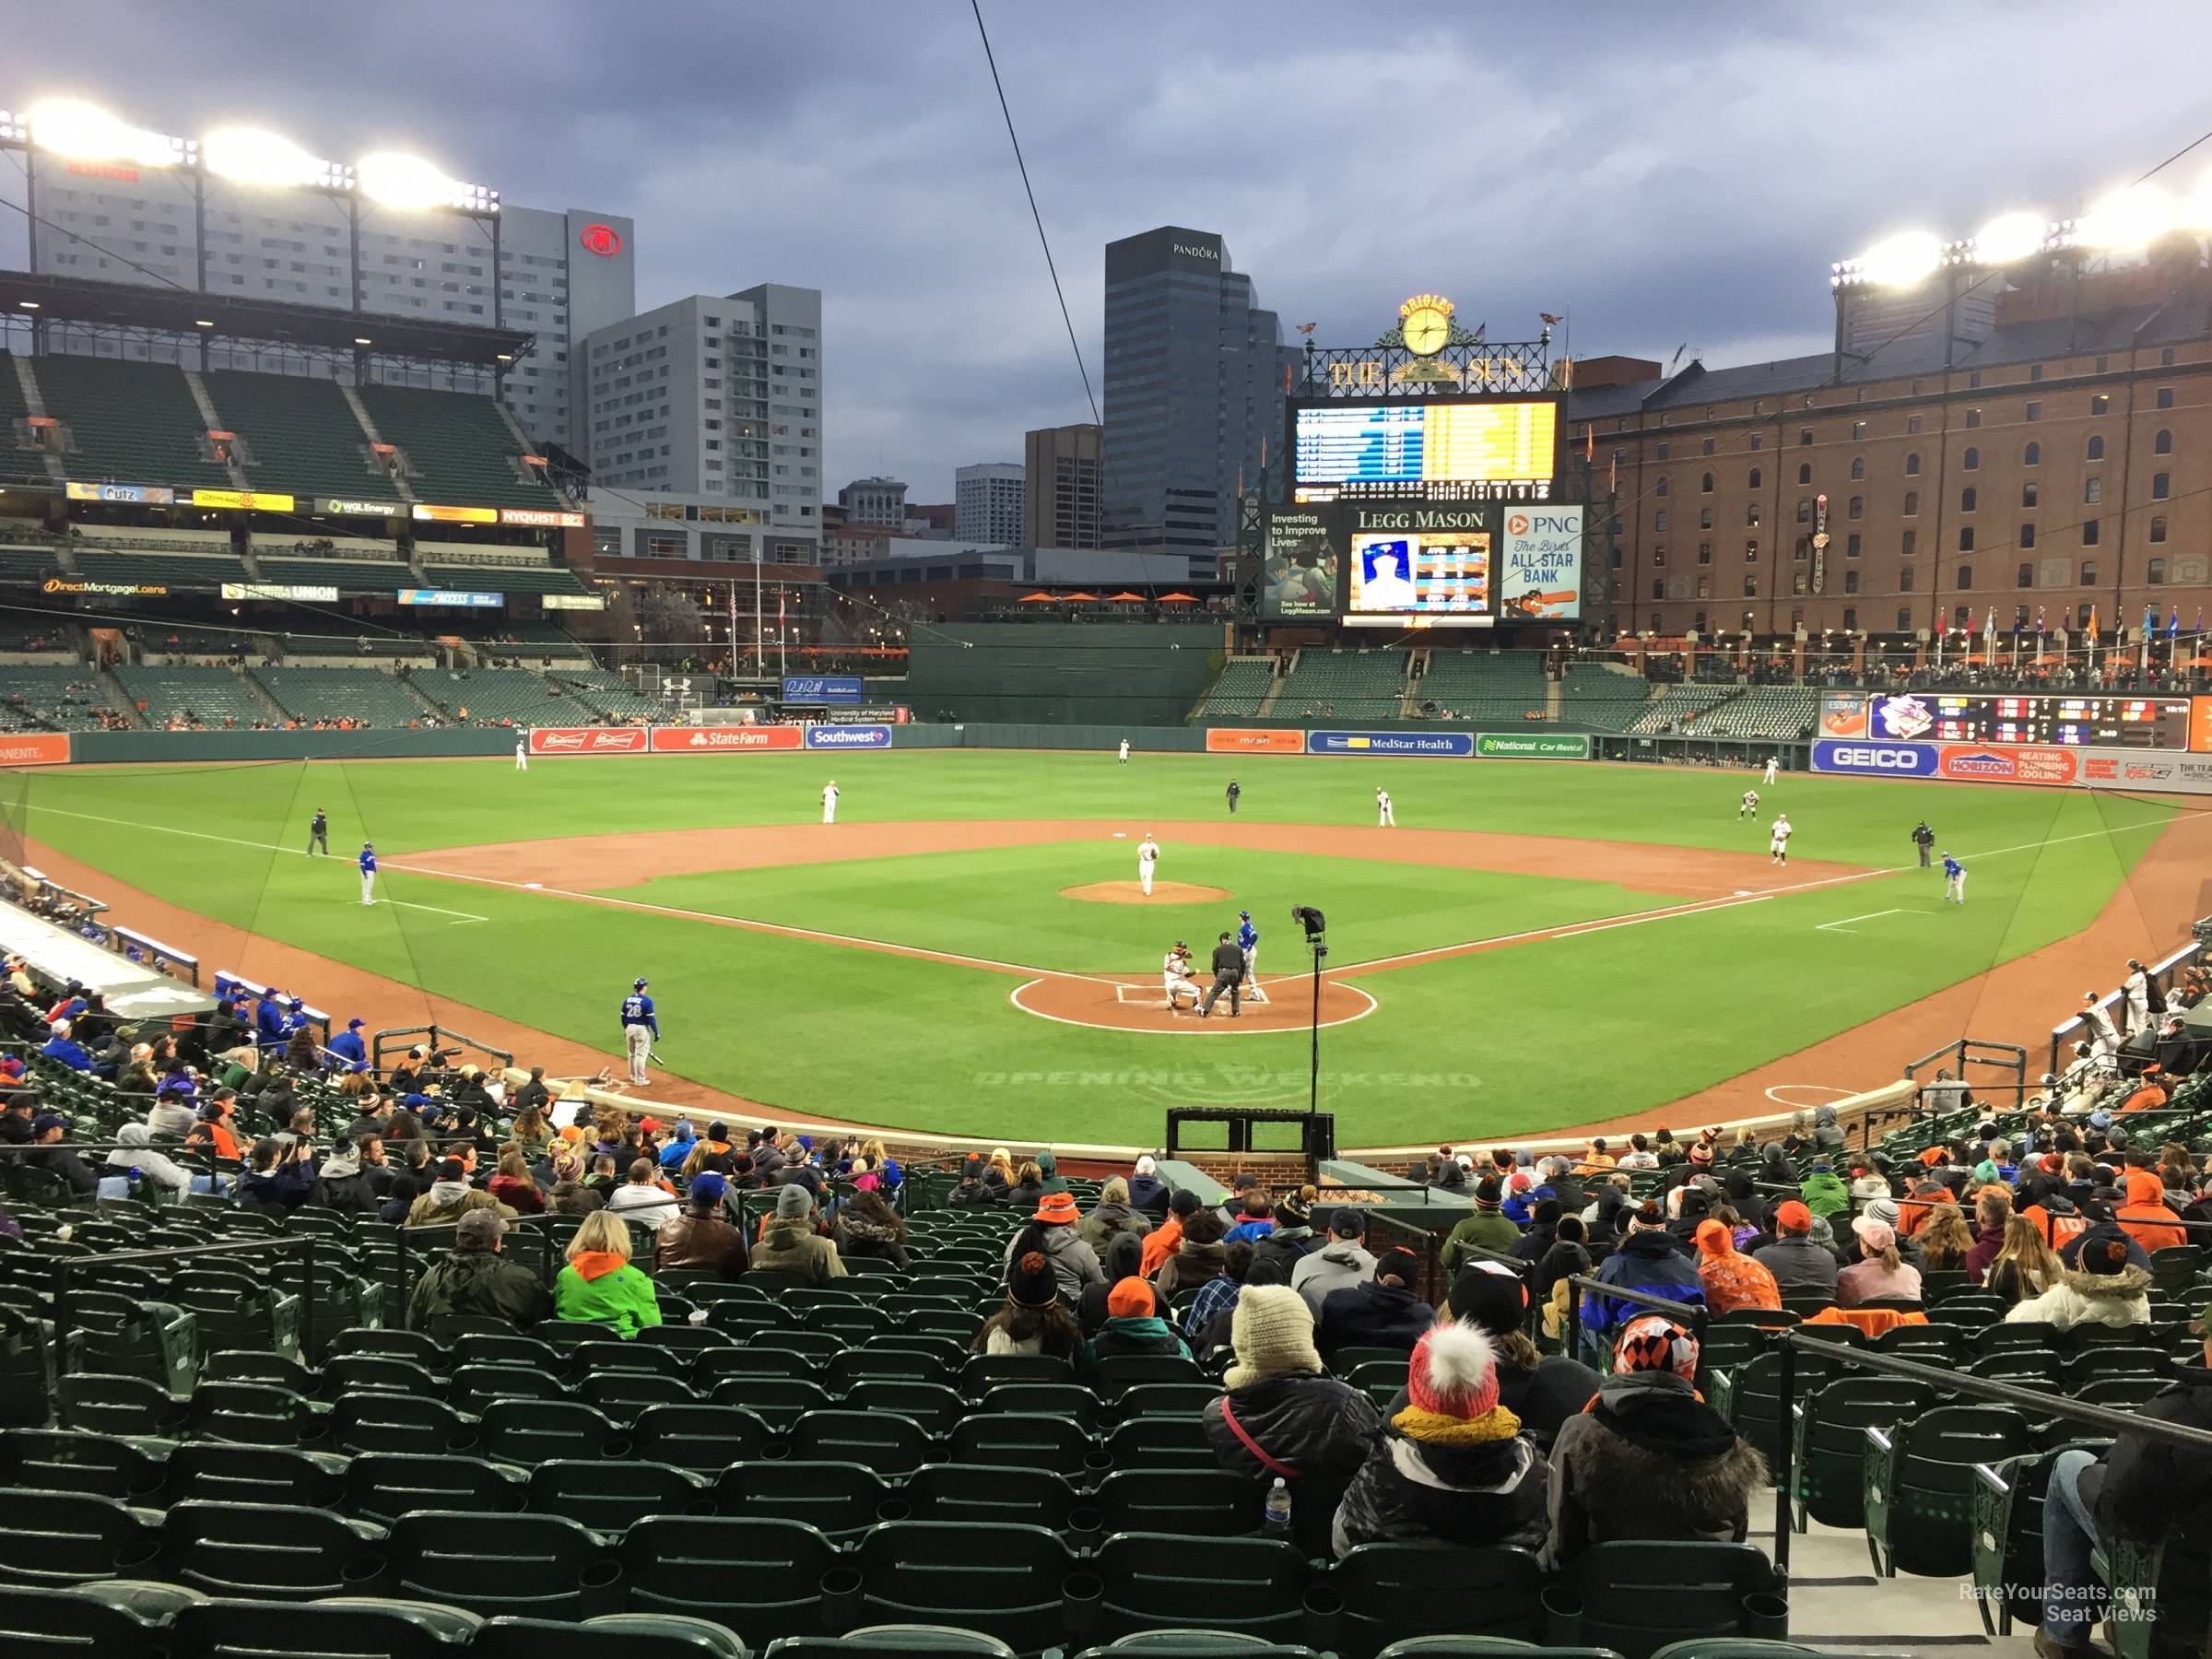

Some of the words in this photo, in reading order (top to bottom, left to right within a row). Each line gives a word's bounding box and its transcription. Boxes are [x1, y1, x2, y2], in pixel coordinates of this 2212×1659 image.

[1399, 294, 1455, 317] ORIOLES
[1329, 362, 1384, 386] THE
[1469, 357, 1524, 382] SUN
[1537, 486, 1549, 499] 2
[365, 503, 395, 514] Energy
[504, 508, 555, 523] NYQUIST
[1271, 514, 1318, 525] Investing
[1359, 512, 1410, 529] LEGG
[1415, 511, 1484, 529] MASON
[1271, 527, 1282, 535] to
[1285, 526, 1327, 536] Improve
[1533, 517, 1578, 533] PNC
[1514, 540, 1535, 552] The
[1524, 569, 1558, 582] BANK
[293, 586, 337, 598] UNION
[1828, 700, 1859, 709] ESSKAY
[815, 730, 875, 743] Southwest
[1371, 739, 1413, 749] MedStar
[1417, 740, 1453, 749] Health
[1496, 740, 1535, 750] National
[1833, 747, 1918, 769] GEICO
[2018, 752, 2062, 762] HEATING
[1950, 761, 2013, 774] HORIZON
[2018, 761, 2069, 772] PLUMBING
[2180, 764, 2194, 773] THE
[2018, 770, 2062, 780] COOLING
[973, 1067, 1206, 1087] OPENING
[1224, 1067, 1482, 1087] WEEKEND
